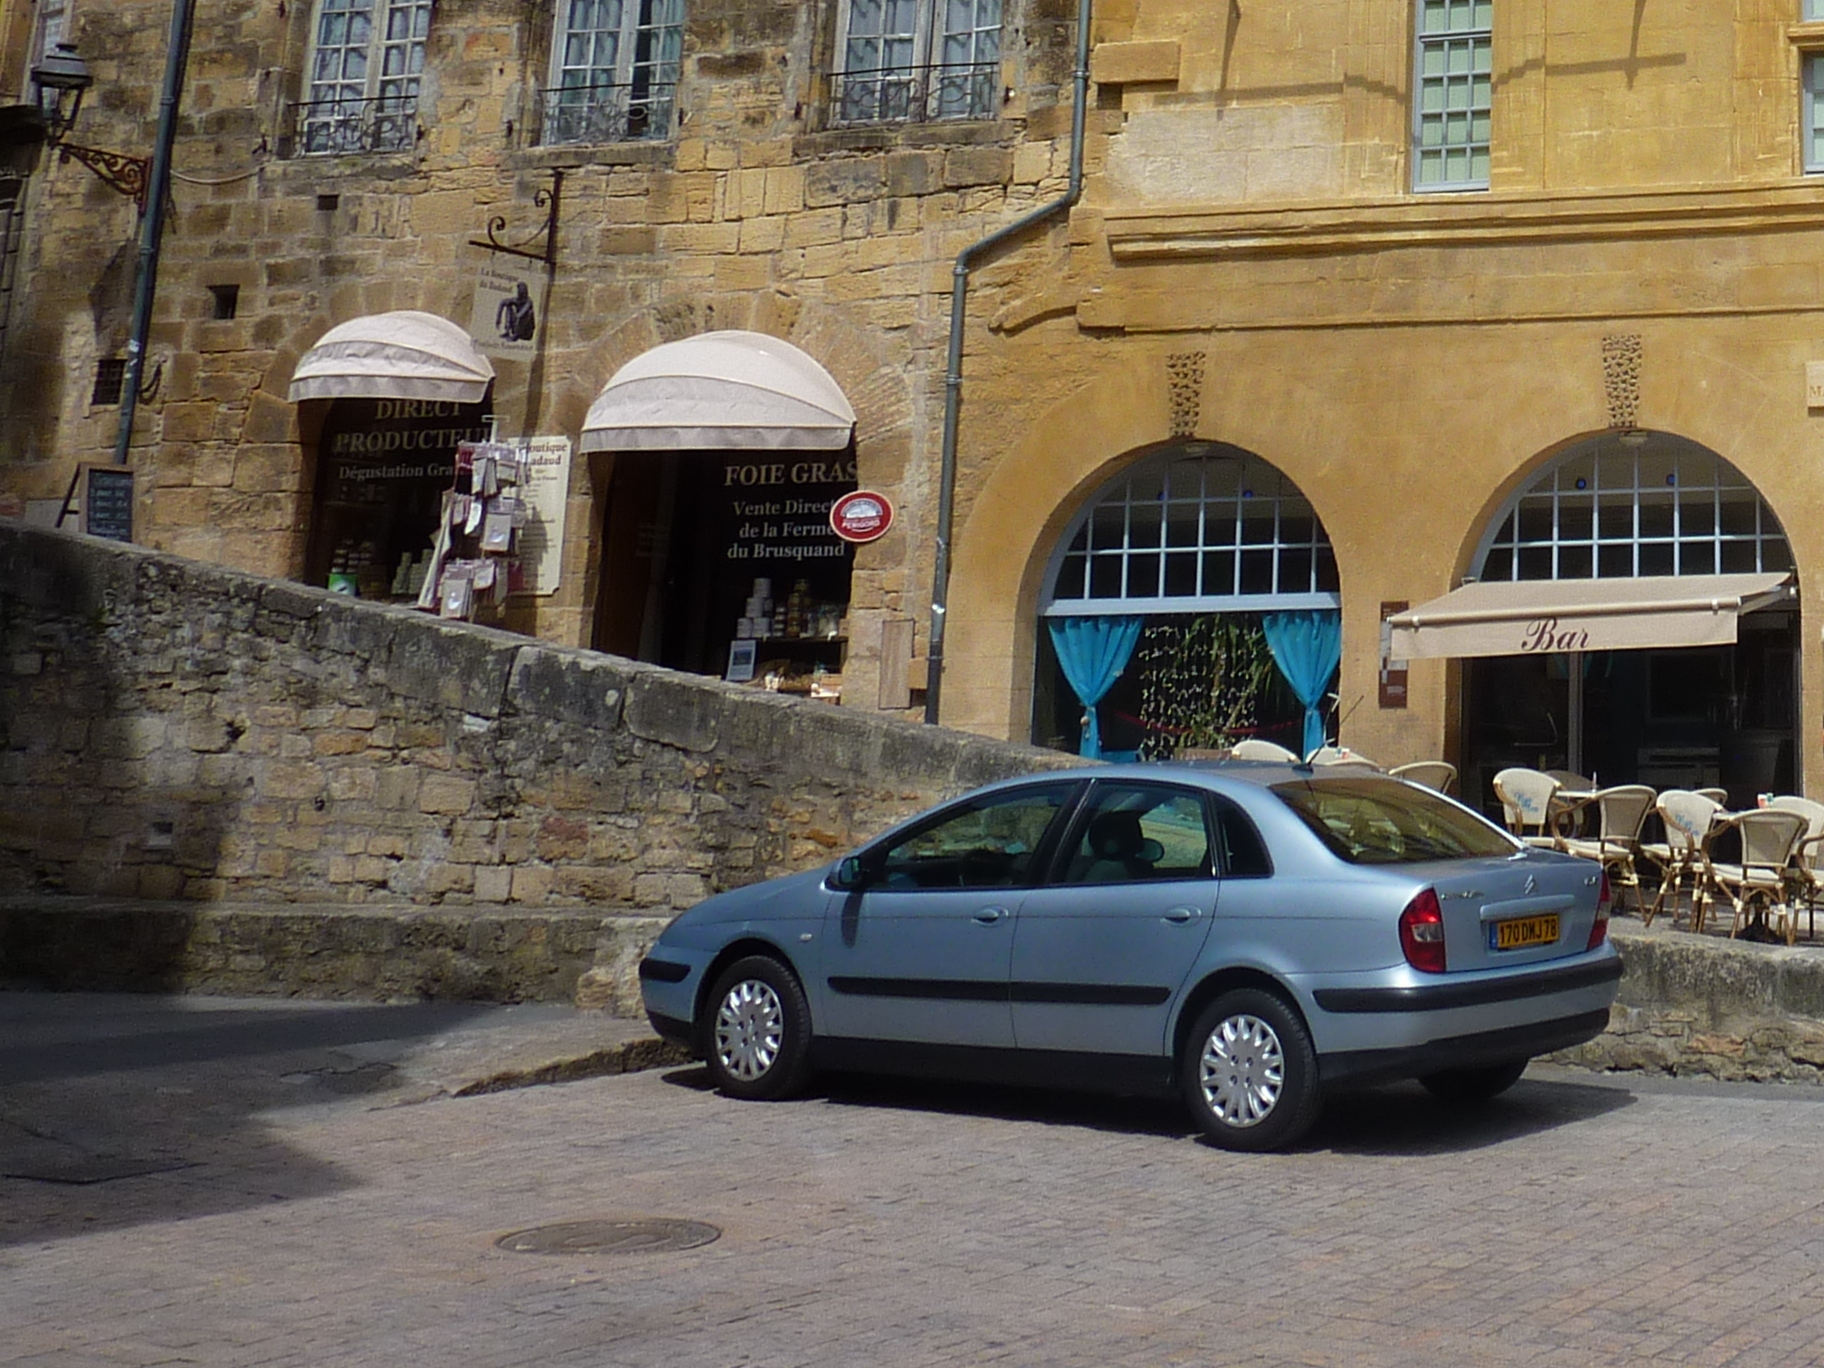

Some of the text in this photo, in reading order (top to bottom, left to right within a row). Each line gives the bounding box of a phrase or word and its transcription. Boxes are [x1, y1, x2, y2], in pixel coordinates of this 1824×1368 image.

[375, 401, 462, 420] DIRECT
[528, 440, 568, 455] outique
[531, 455, 562, 466] adaud
[339, 462, 454, 482] Dégustation Gra
[724, 461, 858, 486] FOIE GRAS
[733, 500, 780, 517] Vente
[785, 498, 835, 515] Direct
[739, 522, 835, 539] de la Ferme
[727, 542, 845, 561] du Brusquand
[1521, 617, 1589, 652] Bar
[1500, 923, 1520, 945] 170
[1544, 918, 1557, 939] 78
